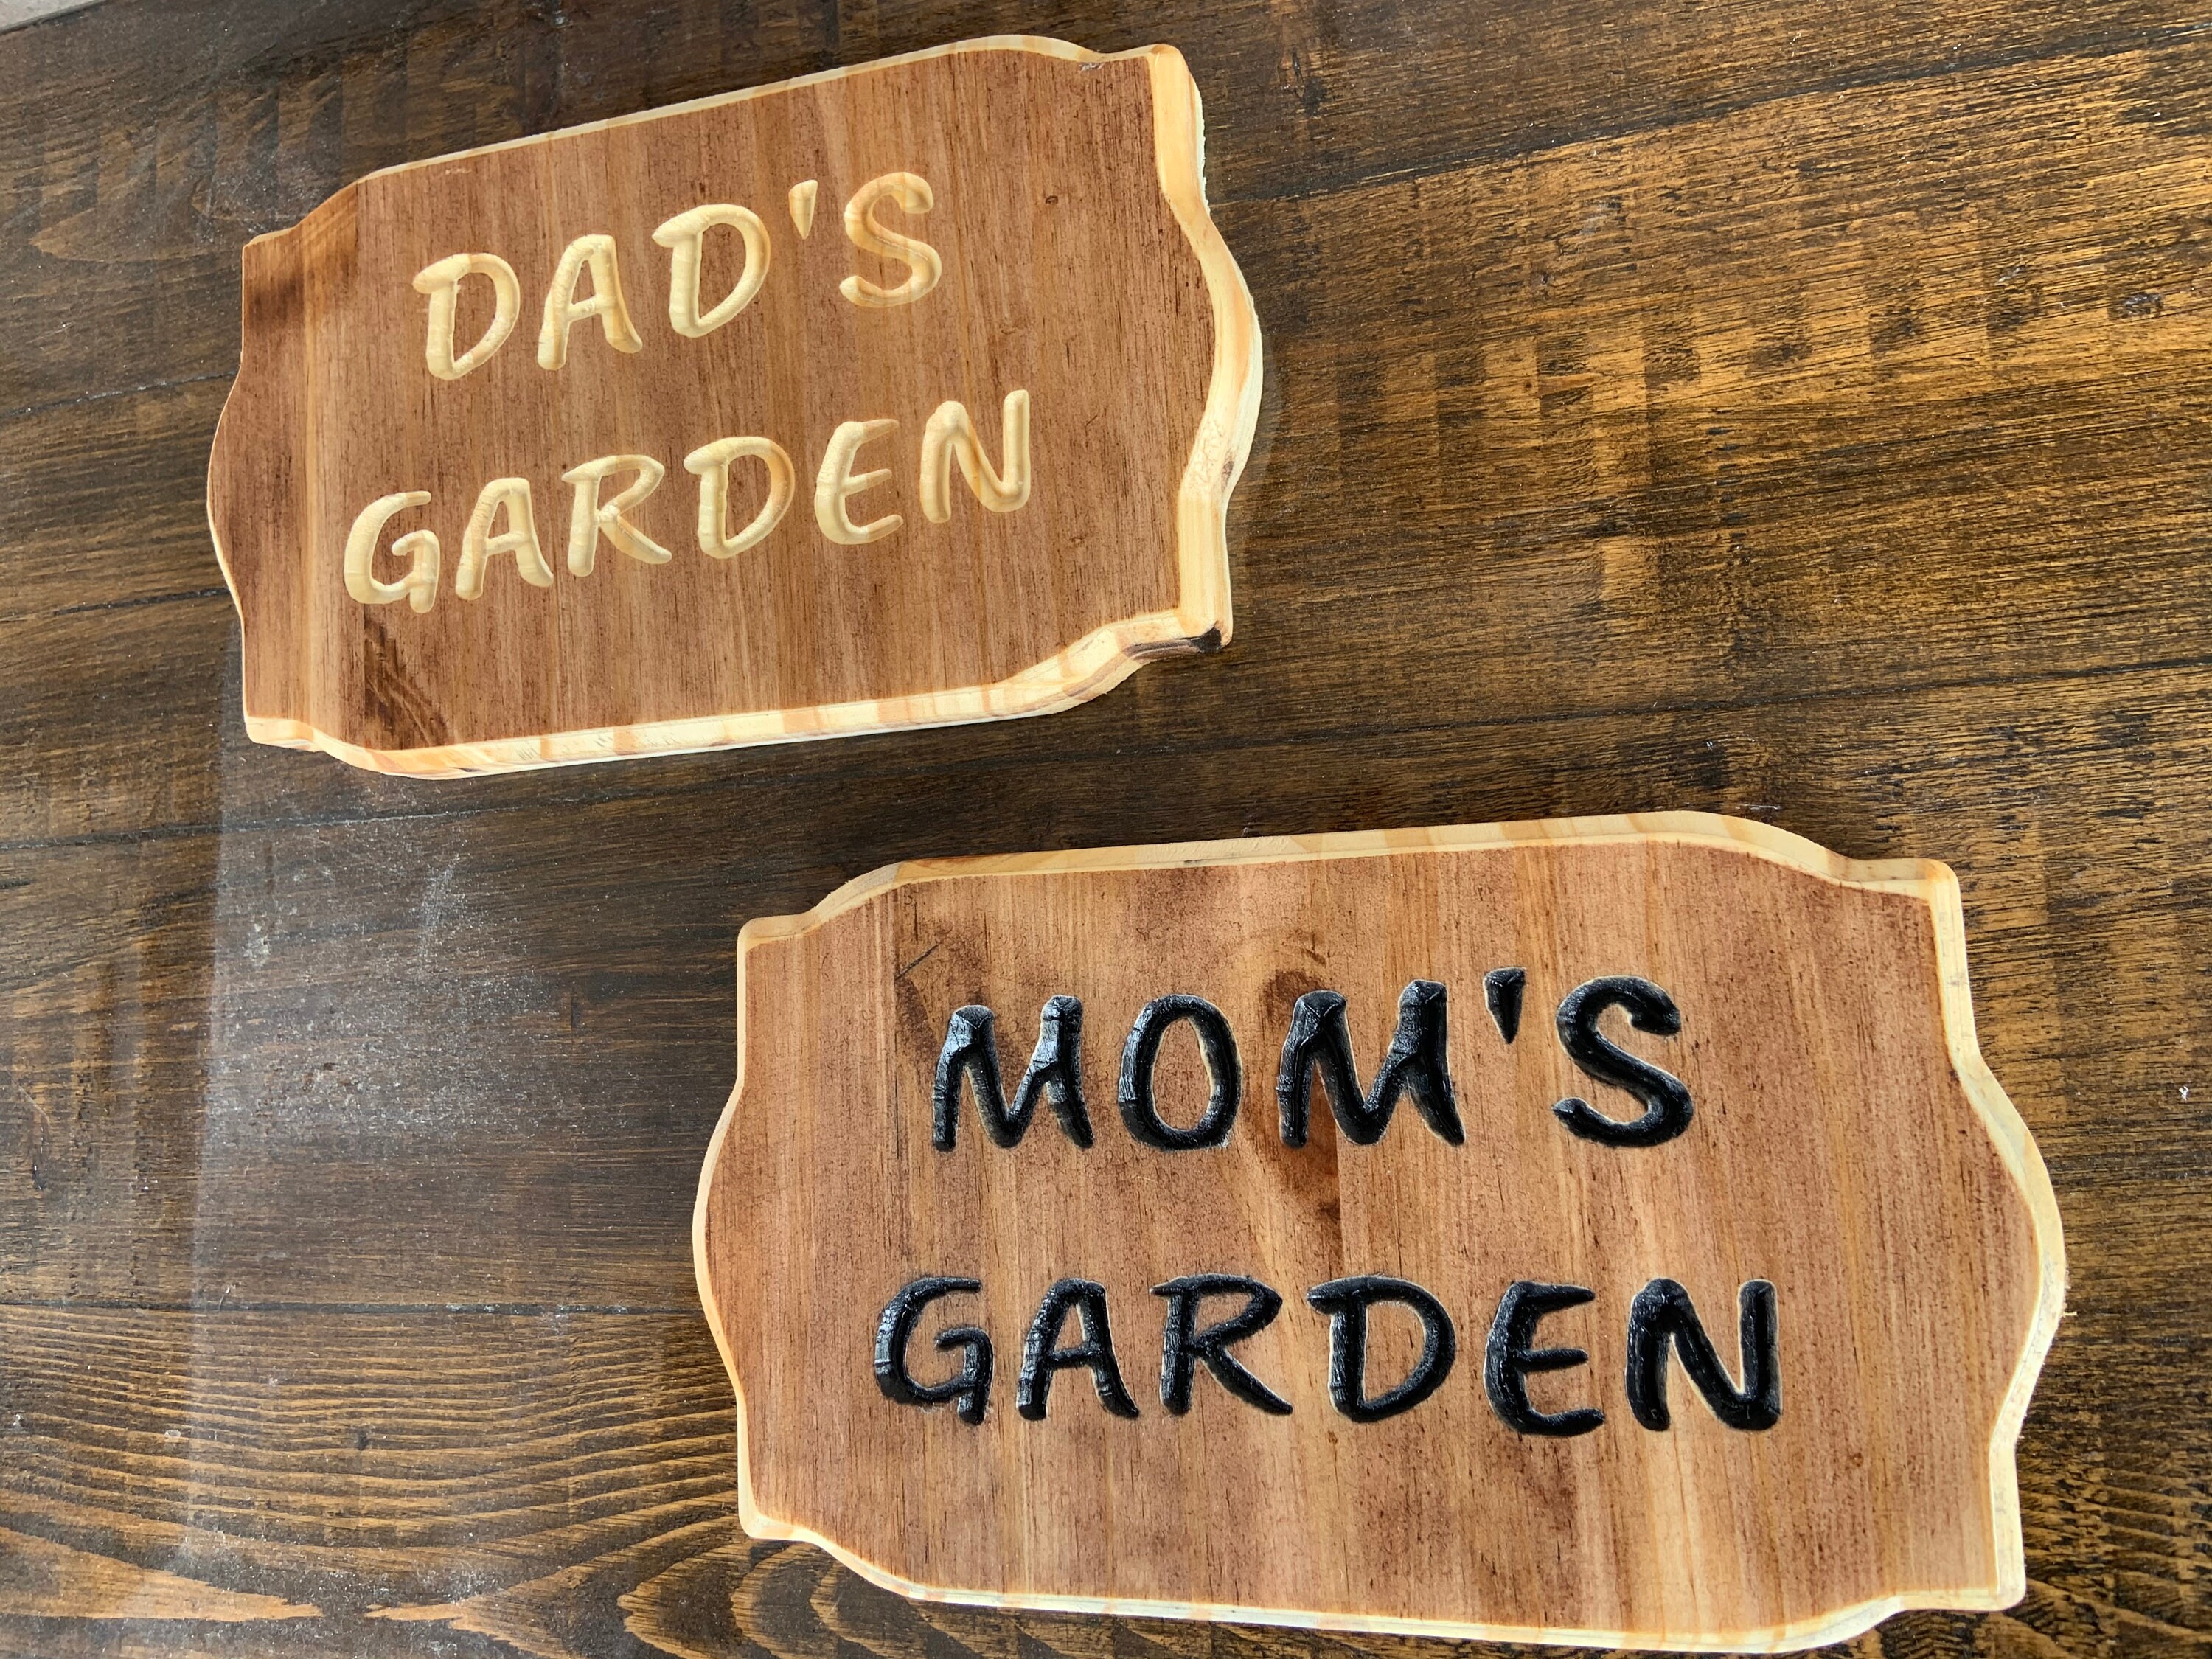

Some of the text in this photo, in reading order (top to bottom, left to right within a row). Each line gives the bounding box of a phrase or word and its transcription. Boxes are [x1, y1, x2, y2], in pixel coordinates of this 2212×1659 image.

[413, 171, 943, 381] DAD'S
[344, 389, 1032, 614] GARDEN
[932, 967, 1693, 1149] MOM'S
[874, 1276, 1781, 1436] GARDEN
